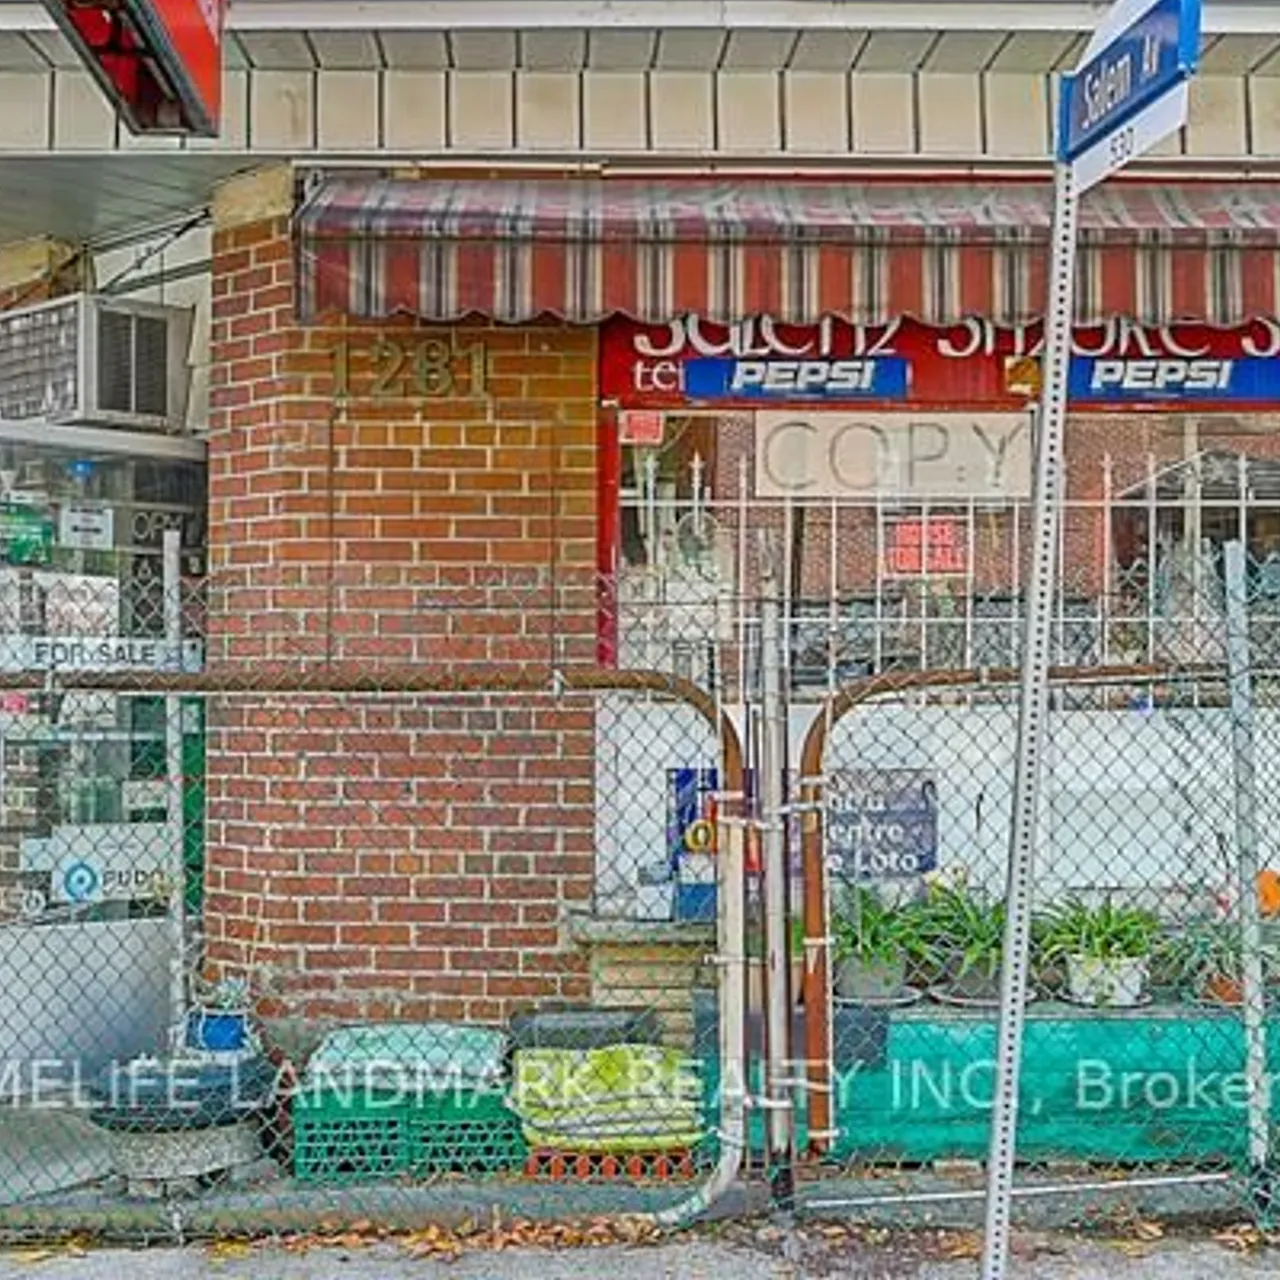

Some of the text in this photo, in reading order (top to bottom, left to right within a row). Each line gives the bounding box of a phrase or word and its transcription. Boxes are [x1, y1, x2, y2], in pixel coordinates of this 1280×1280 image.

[329, 338, 489, 402] 1281
[730, 360, 876, 390] PEPSI
[1090, 358, 1234, 390] PEPSI
[762, 420, 1030, 489] COPY
[33, 642, 157, 664] FOR SALE
